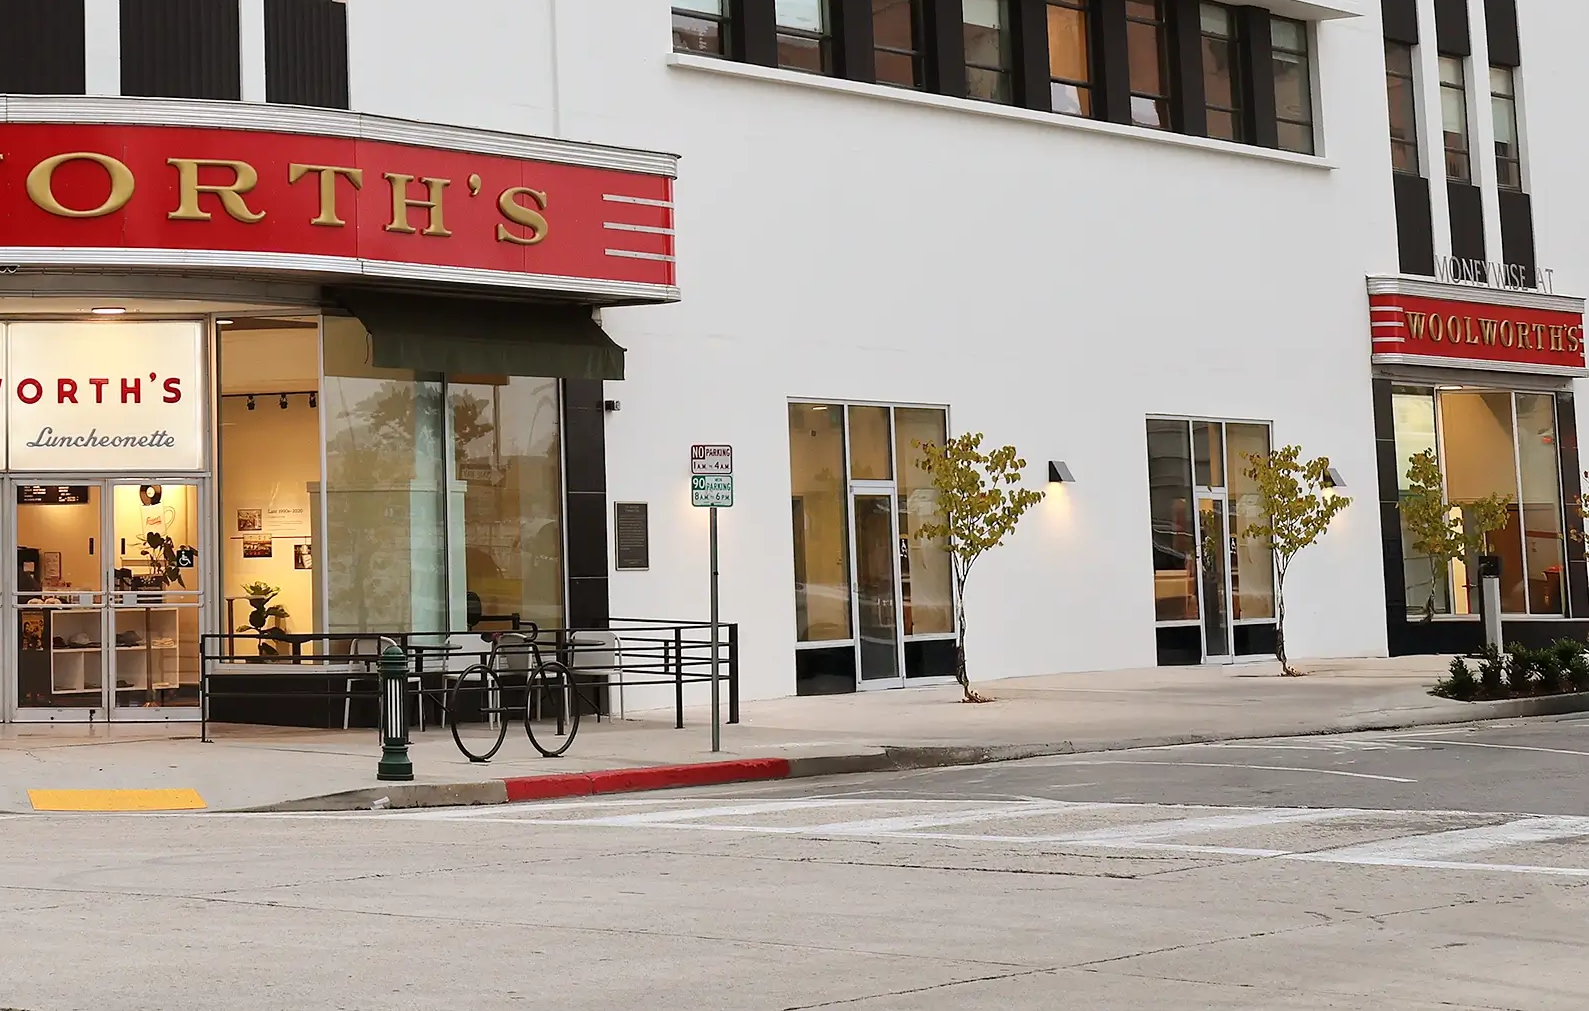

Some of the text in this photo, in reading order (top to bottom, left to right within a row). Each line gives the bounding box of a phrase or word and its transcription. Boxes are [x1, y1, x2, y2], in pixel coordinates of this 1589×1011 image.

[1434, 255, 1554, 294] MONEYWISE AT
[1405, 311, 1579, 352] WOOLWORTH'S
[27, 426, 176, 448] Luncheonette
[693, 446, 730, 458] NO PARKING
[693, 478, 705, 489] 90
